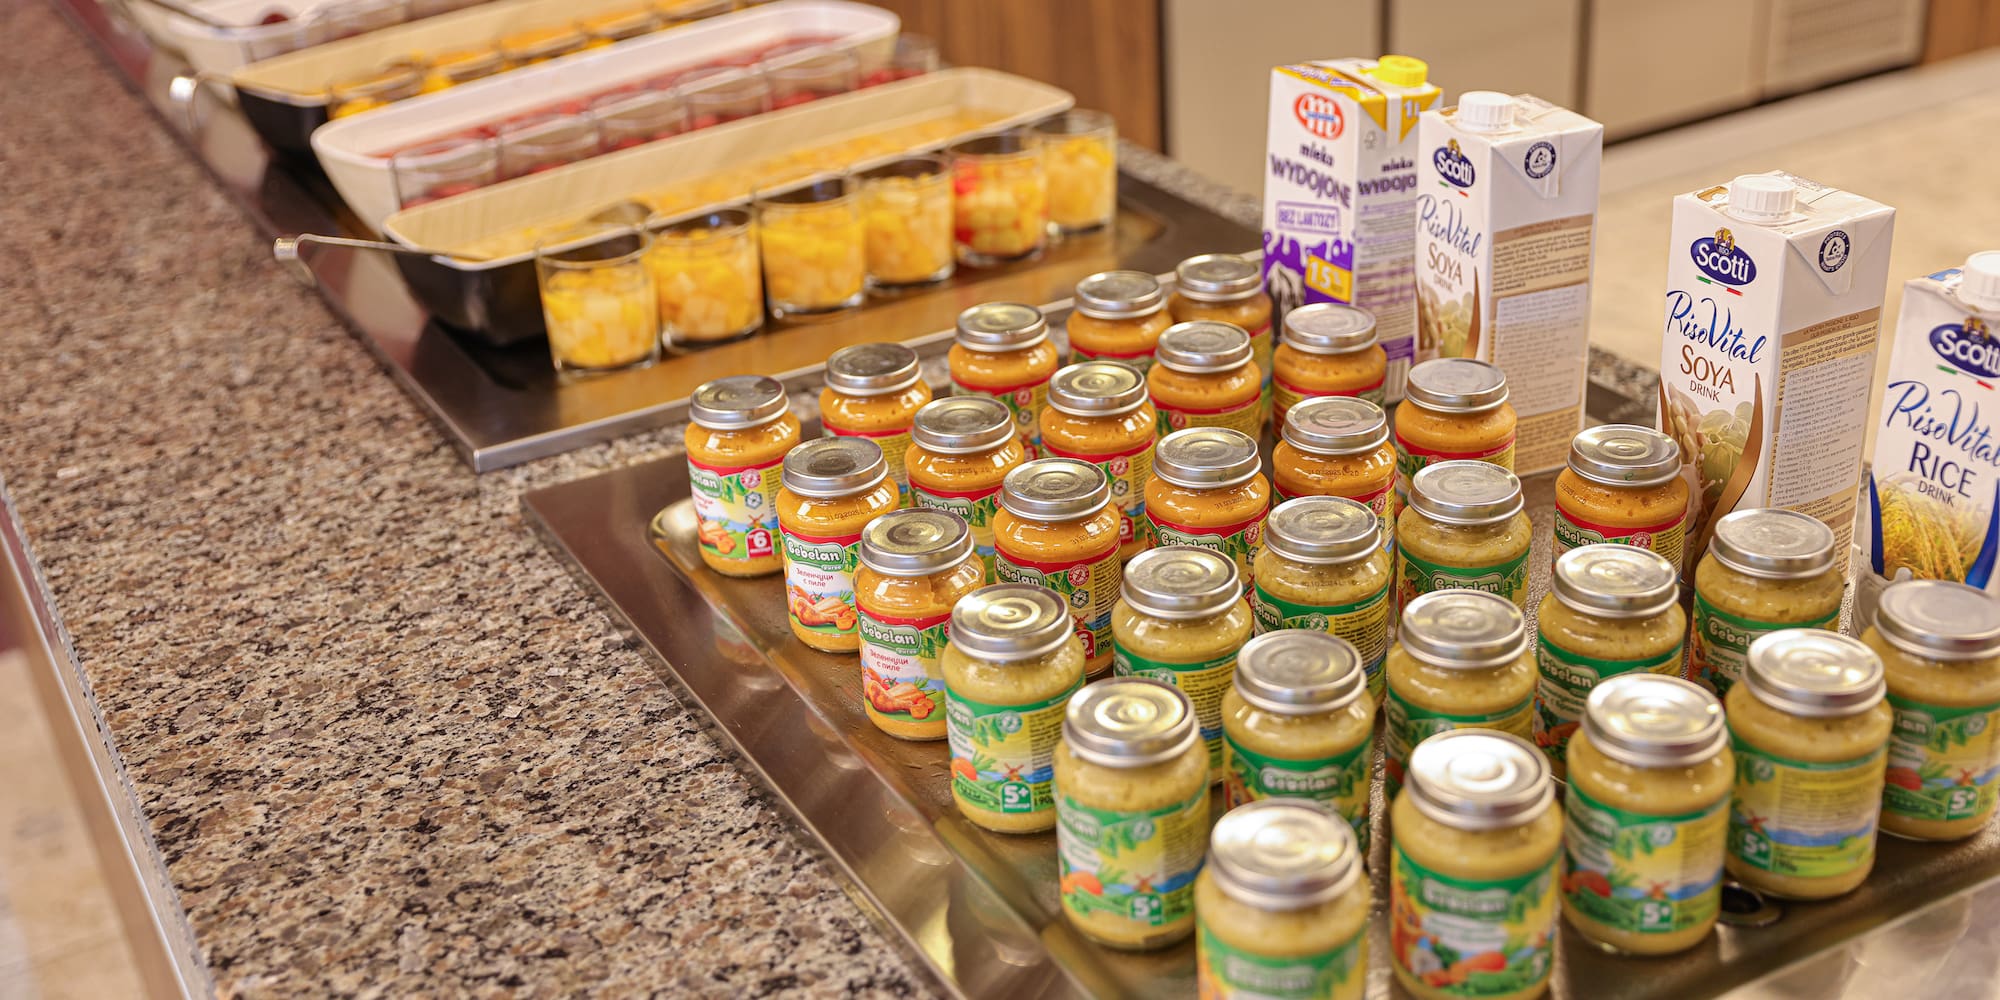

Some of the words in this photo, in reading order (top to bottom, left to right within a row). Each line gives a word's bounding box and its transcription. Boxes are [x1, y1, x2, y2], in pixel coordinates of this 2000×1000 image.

[1270, 154, 1352, 208] WYDOJONE
[1436, 149, 1473, 185] Scotti
[1357, 173, 1417, 195] WYDOJO
[1427, 242, 1463, 286] SOYA
[1696, 243, 1750, 283] Scotti
[1666, 290, 1767, 364] RisoVital
[1937, 330, 2000, 376] Scott
[1680, 344, 1735, 394] SOYA
[1690, 380, 1720, 403] DRINK
[1909, 441, 1976, 498] RICE
[1918, 480, 1955, 508] DRINK
[753, 531, 767, 548] 6
[795, 567, 834, 582] Зеленчуци
[1710, 621, 1751, 647] Bebel
[870, 649, 909, 665] Зеленчуци
[882, 662, 901, 671] пиле
[1004, 785, 1029, 804] 5+
